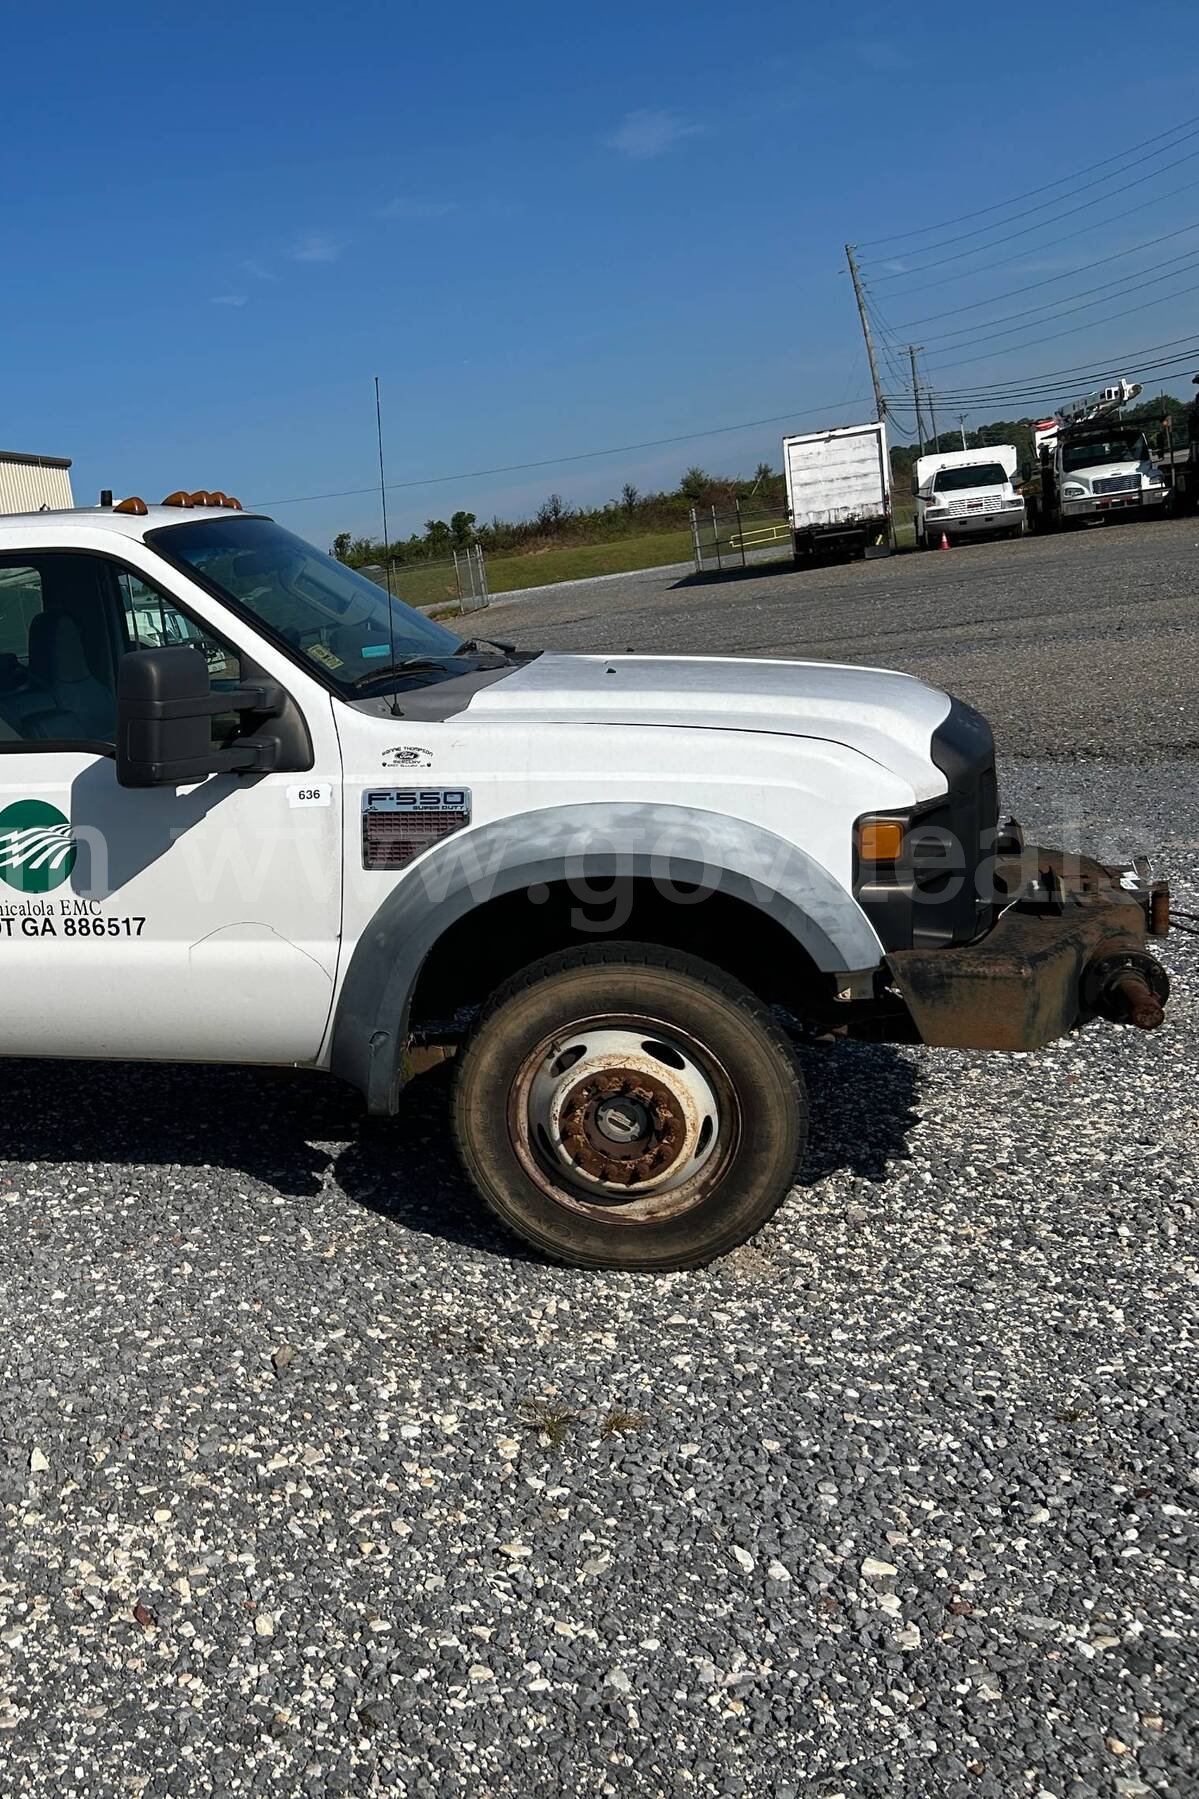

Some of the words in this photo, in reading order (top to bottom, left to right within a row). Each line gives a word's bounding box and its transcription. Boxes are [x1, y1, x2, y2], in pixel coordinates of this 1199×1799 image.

[298, 789, 320, 800] 636
[368, 792, 464, 805] F-550
[60, 900, 102, 916] EMC
[21, 917, 57, 937] GA
[64, 916, 146, 936] 886517
